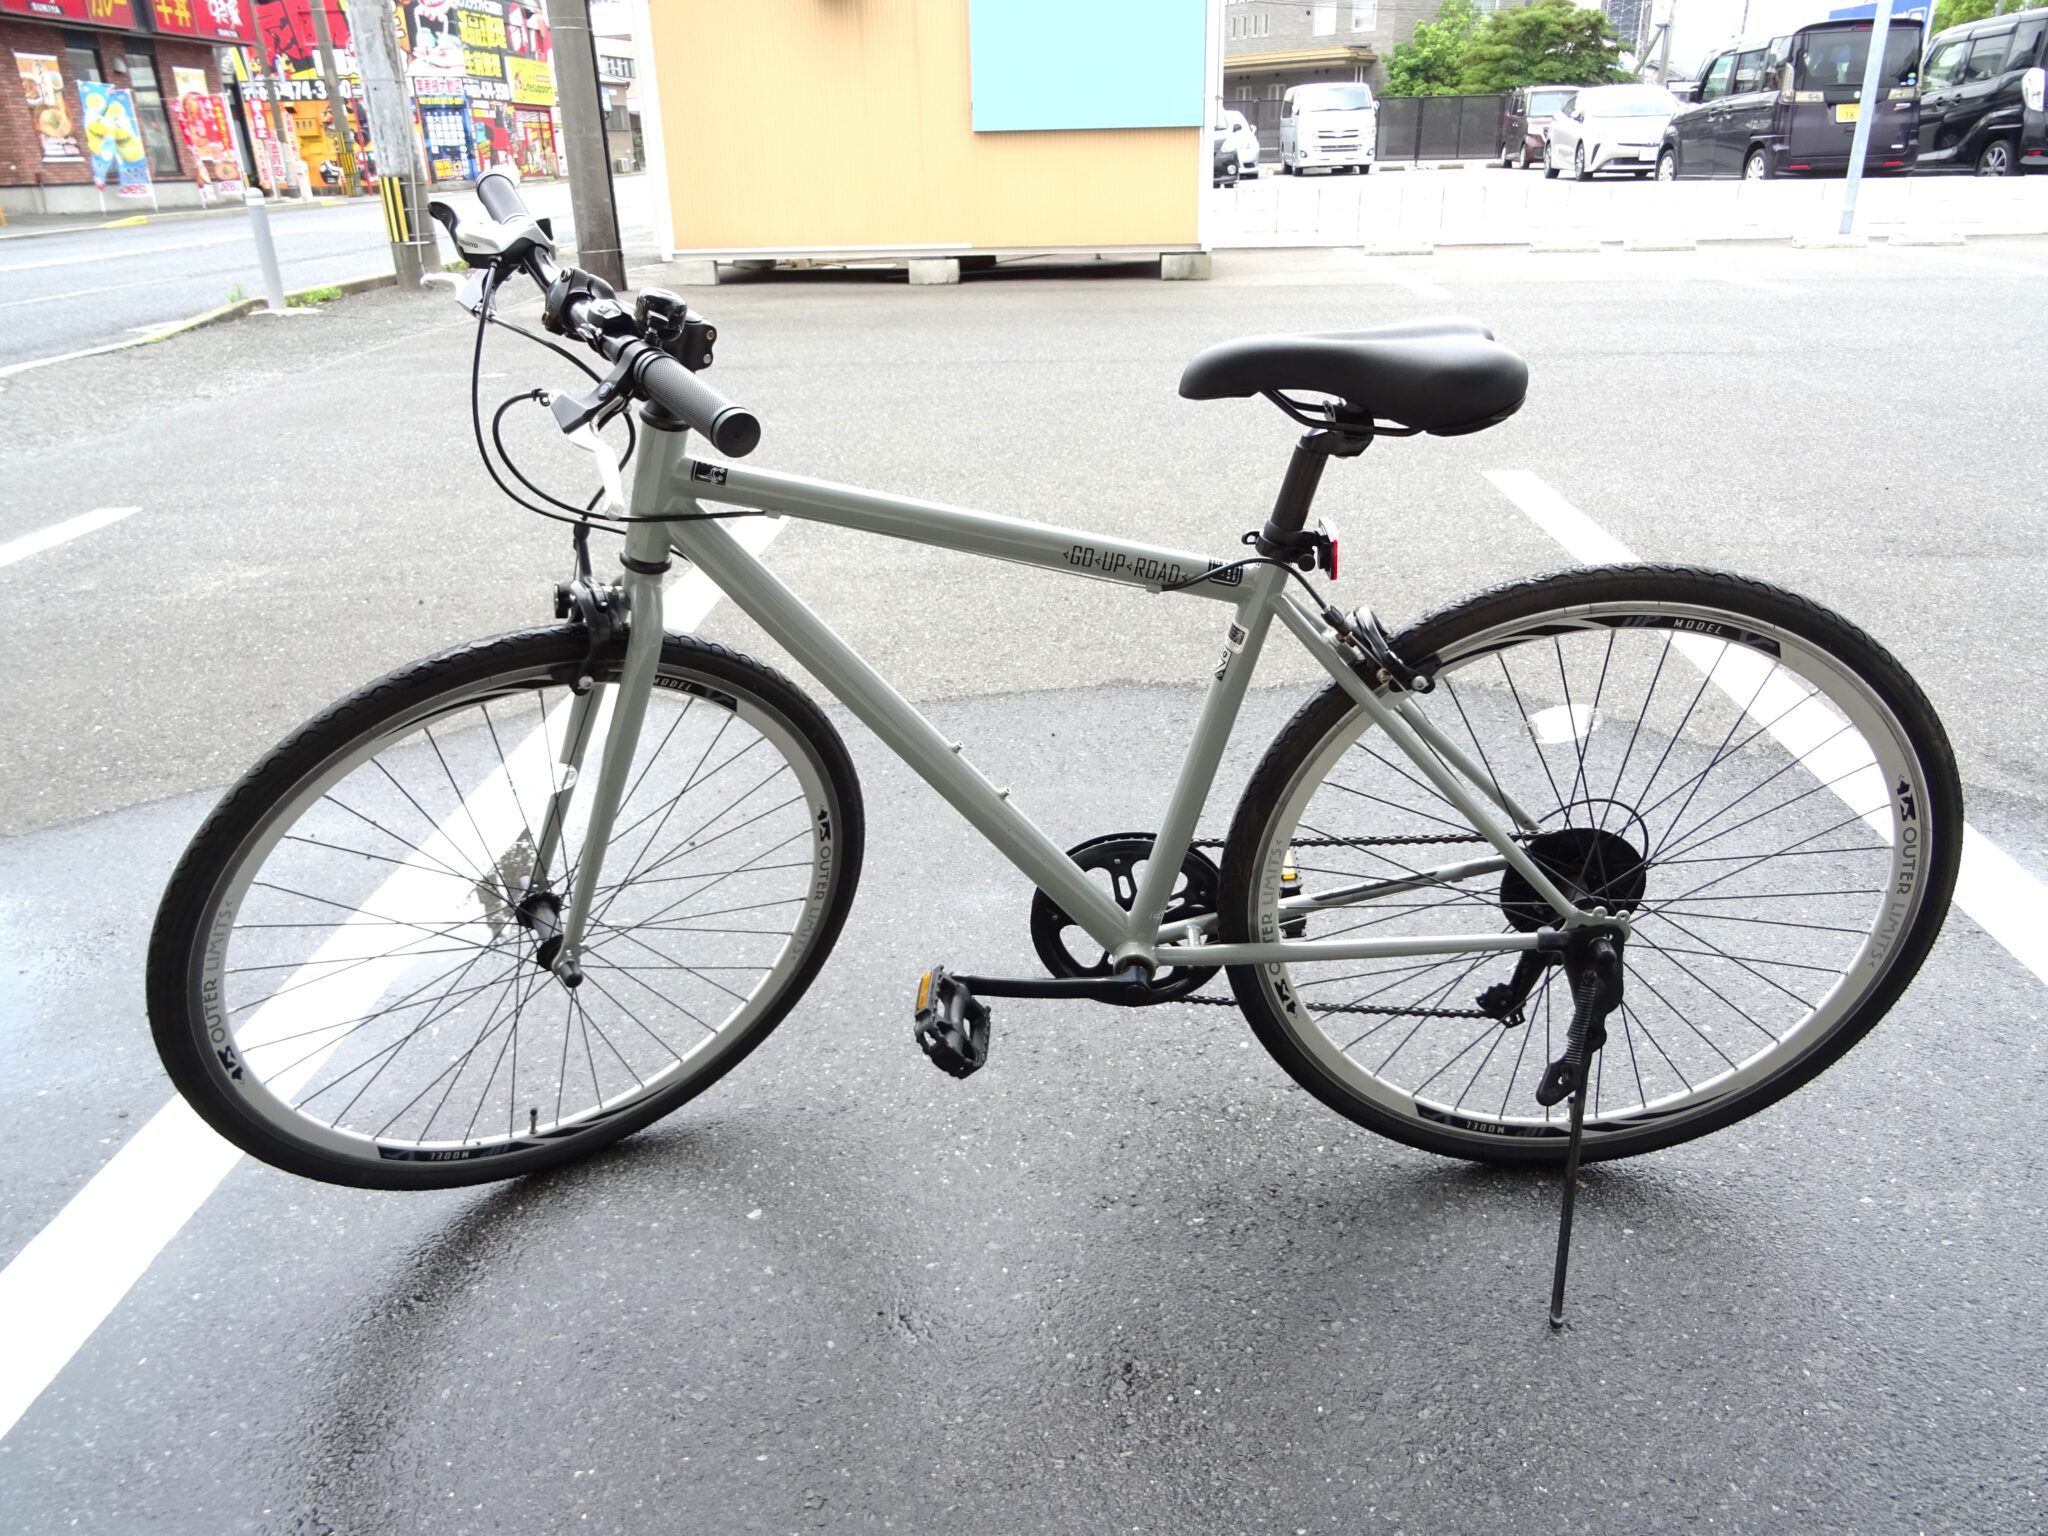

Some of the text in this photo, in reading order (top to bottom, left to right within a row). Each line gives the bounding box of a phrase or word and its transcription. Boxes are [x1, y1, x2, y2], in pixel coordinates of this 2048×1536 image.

[1673, 618, 1723, 635] MODEL
[793, 845, 833, 955] OUTER LIMITS
[1261, 848, 1283, 976] OTER LIMITS
[1871, 826, 1918, 965] OUTER LIMITS
[203, 909, 232, 1043] OUTER LIMITS
[430, 1151, 470, 1161] MODEL
[1466, 1120, 1505, 1134] MODEL
